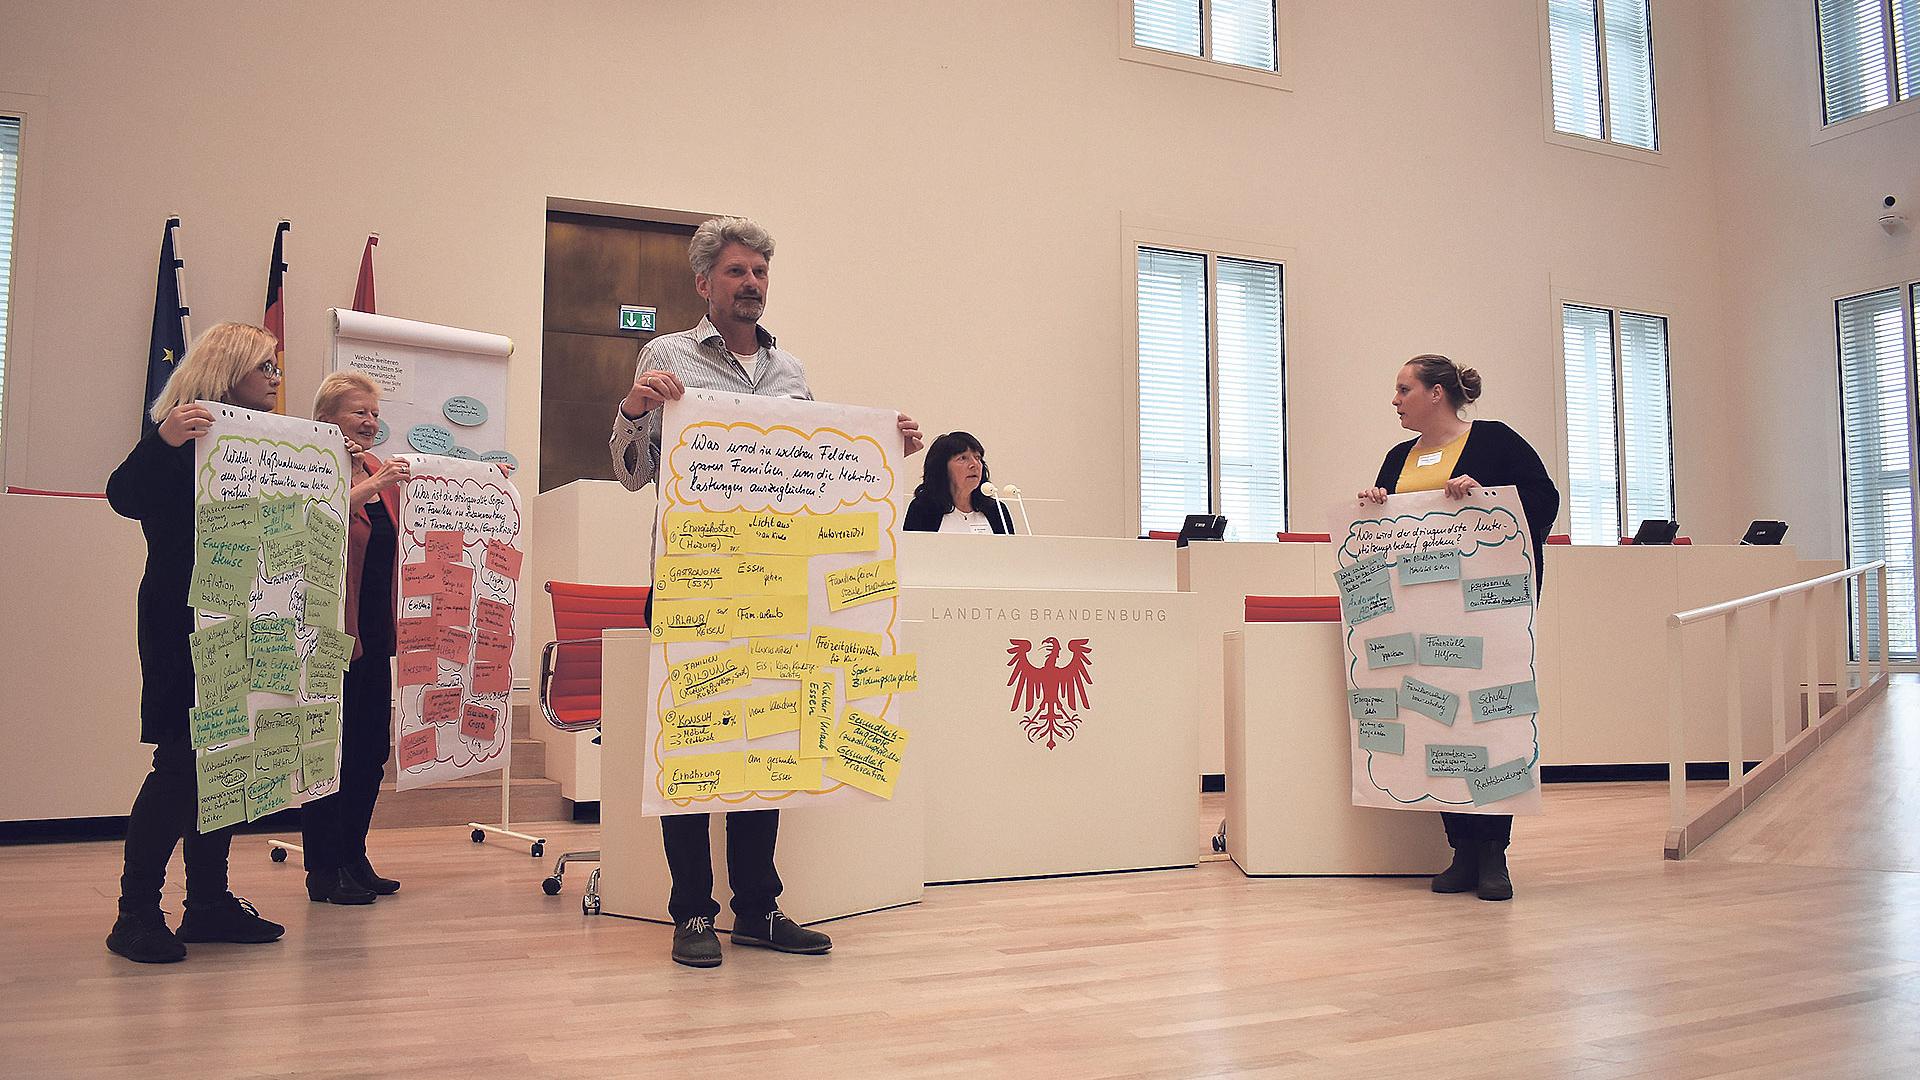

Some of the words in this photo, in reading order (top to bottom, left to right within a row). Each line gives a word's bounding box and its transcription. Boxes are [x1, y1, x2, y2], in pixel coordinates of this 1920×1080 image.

[350, 360, 376, 369] Angebote
[354, 354, 374, 362] Welche
[376, 358, 399, 366] weiteren
[691, 434, 720, 451] Was
[727, 441, 757, 454] und
[759, 445, 772, 455] in
[775, 446, 814, 460] welchen
[222, 445, 253, 464] Welche
[257, 449, 307, 473] Maßnahmen
[220, 471, 237, 481] aus
[239, 466, 257, 482] Sicht
[260, 474, 270, 485] der
[269, 472, 297, 488] Familien
[689, 461, 724, 479] sparen
[792, 468, 814, 479] um
[816, 467, 835, 481] die
[412, 484, 430, 499] Was
[431, 489, 443, 499] ist
[443, 490, 453, 501] die
[488, 494, 505, 511] Sorge
[690, 477, 743, 499] lastungen
[414, 504, 425, 513] von
[426, 501, 452, 516] Familien
[413, 517, 426, 528] mit
[683, 520, 741, 538] Energiekosten
[1376, 529, 1393, 540] wird
[1396, 527, 1410, 539] der
[1412, 523, 1467, 541] dringendste
[737, 562, 765, 574] Essen
[197, 573, 235, 591] Inflation
[201, 592, 246, 612] bekämpfen
[931, 607, 1021, 620] LANDTAG
[1030, 608, 1167, 621] BRANDENBURG
[683, 660, 736, 686] BILDUNG
[808, 682, 819, 716] Essen
[821, 681, 832, 713] Kultur
[672, 768, 721, 786] Ernährung
